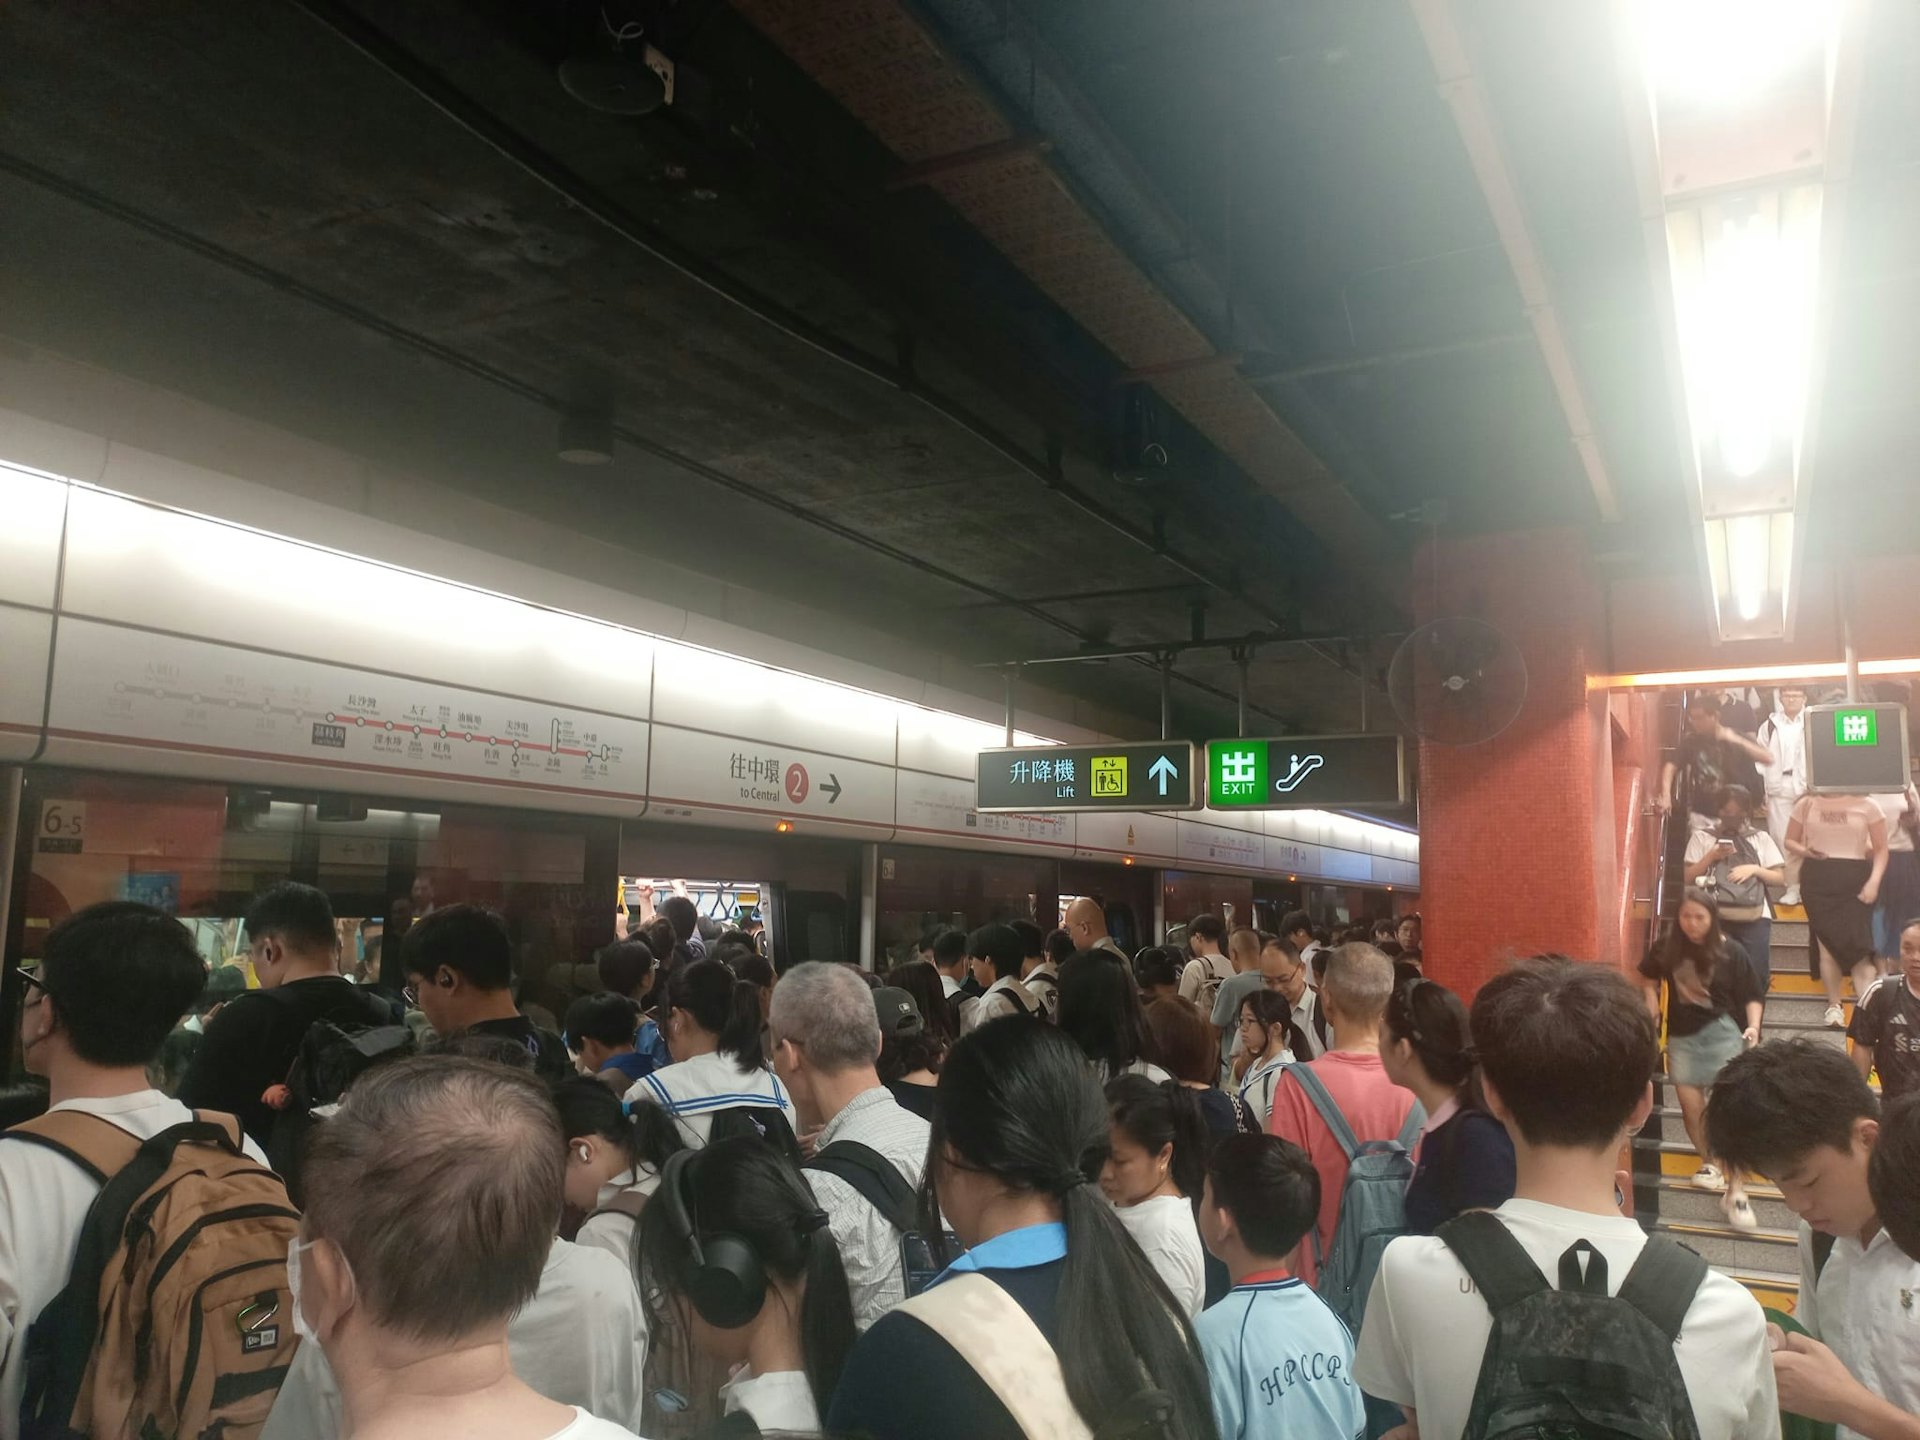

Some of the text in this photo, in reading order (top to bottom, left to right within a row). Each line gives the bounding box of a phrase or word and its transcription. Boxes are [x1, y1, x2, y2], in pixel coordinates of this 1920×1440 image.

[1843, 733, 1868, 742] EXIT
[730, 752, 780, 784] 往中環
[1009, 759, 1075, 785] 升降機
[1221, 752, 1254, 782] 出
[740, 788, 780, 803] to Central
[791, 770, 803, 797] 2
[1056, 786, 1075, 799] Lift
[1221, 782, 1254, 795] EXIT
[44, 805, 83, 835] 6-5
[1259, 1352, 1351, 1406] HPCCP
